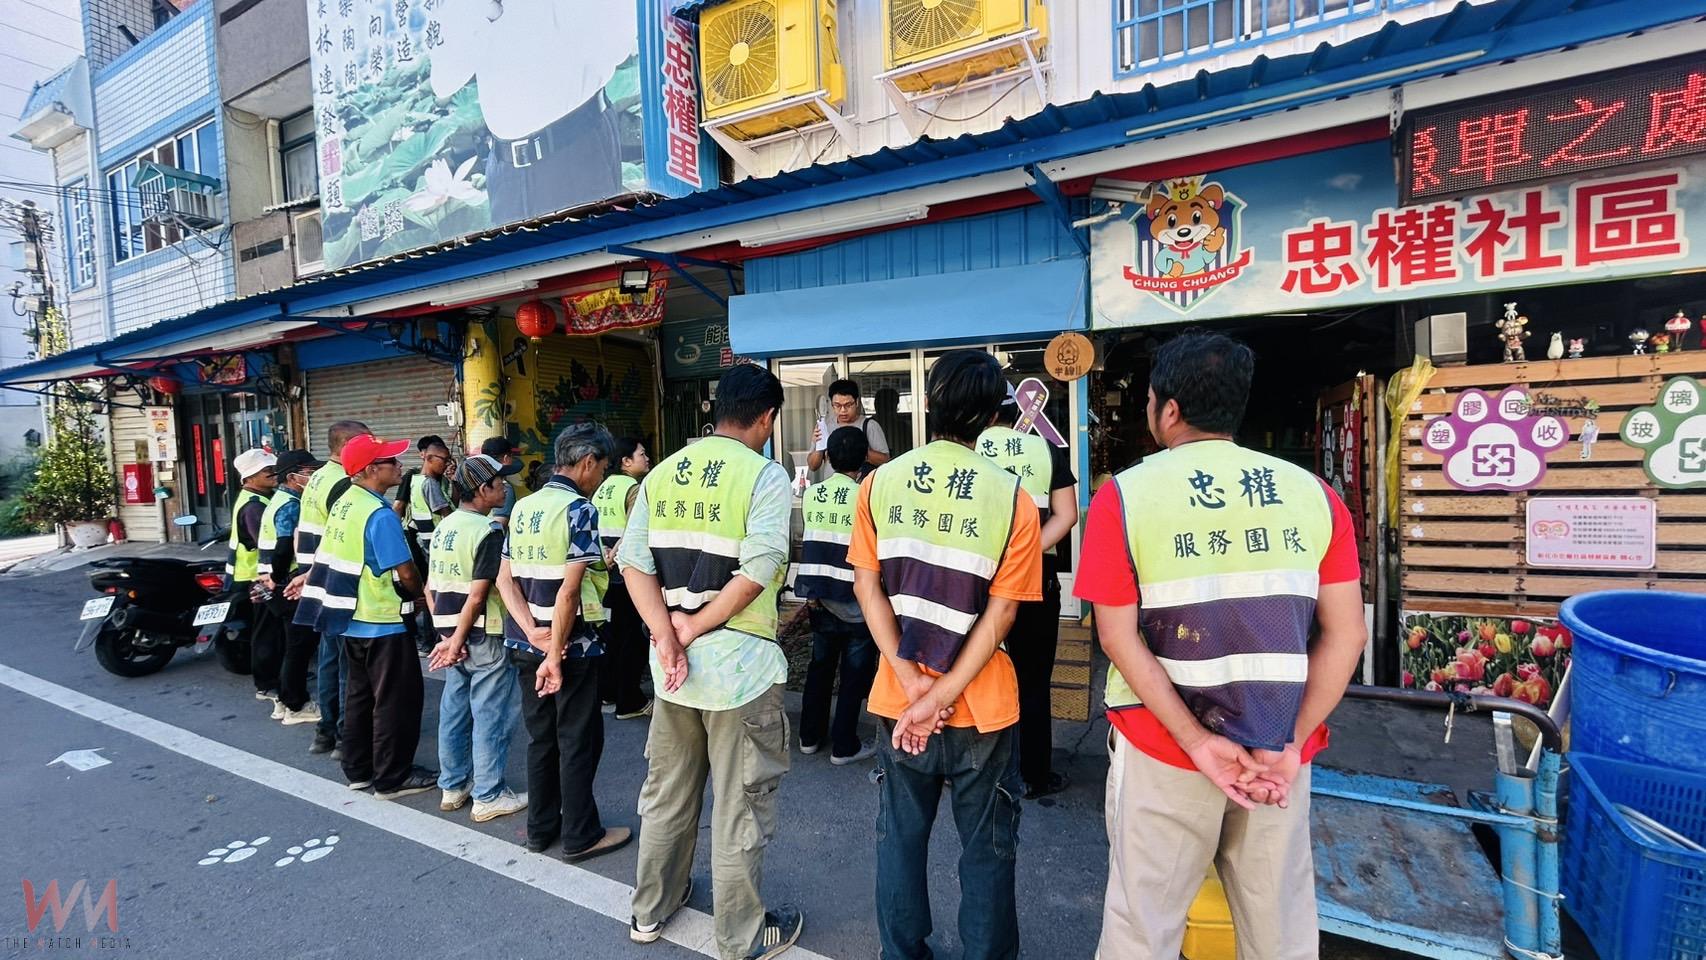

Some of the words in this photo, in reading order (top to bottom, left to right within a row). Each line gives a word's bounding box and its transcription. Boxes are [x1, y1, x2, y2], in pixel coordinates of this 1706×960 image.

[1281, 173, 1682, 296] 忠權社區
[1134, 278, 1178, 289] CHUNG
[1182, 266, 1236, 288] CHUANG
[1631, 390, 1692, 439] 玻璃
[981, 438, 1024, 457] 忠權
[671, 456, 727, 489] 忠權
[907, 461, 979, 500] 忠權
[1187, 466, 1284, 509] 忠權
[655, 500, 721, 522] 服務團隊
[813, 484, 850, 505] 忠權
[888, 505, 980, 538] 服務團隊
[1174, 526, 1307, 559] 服務團隊
